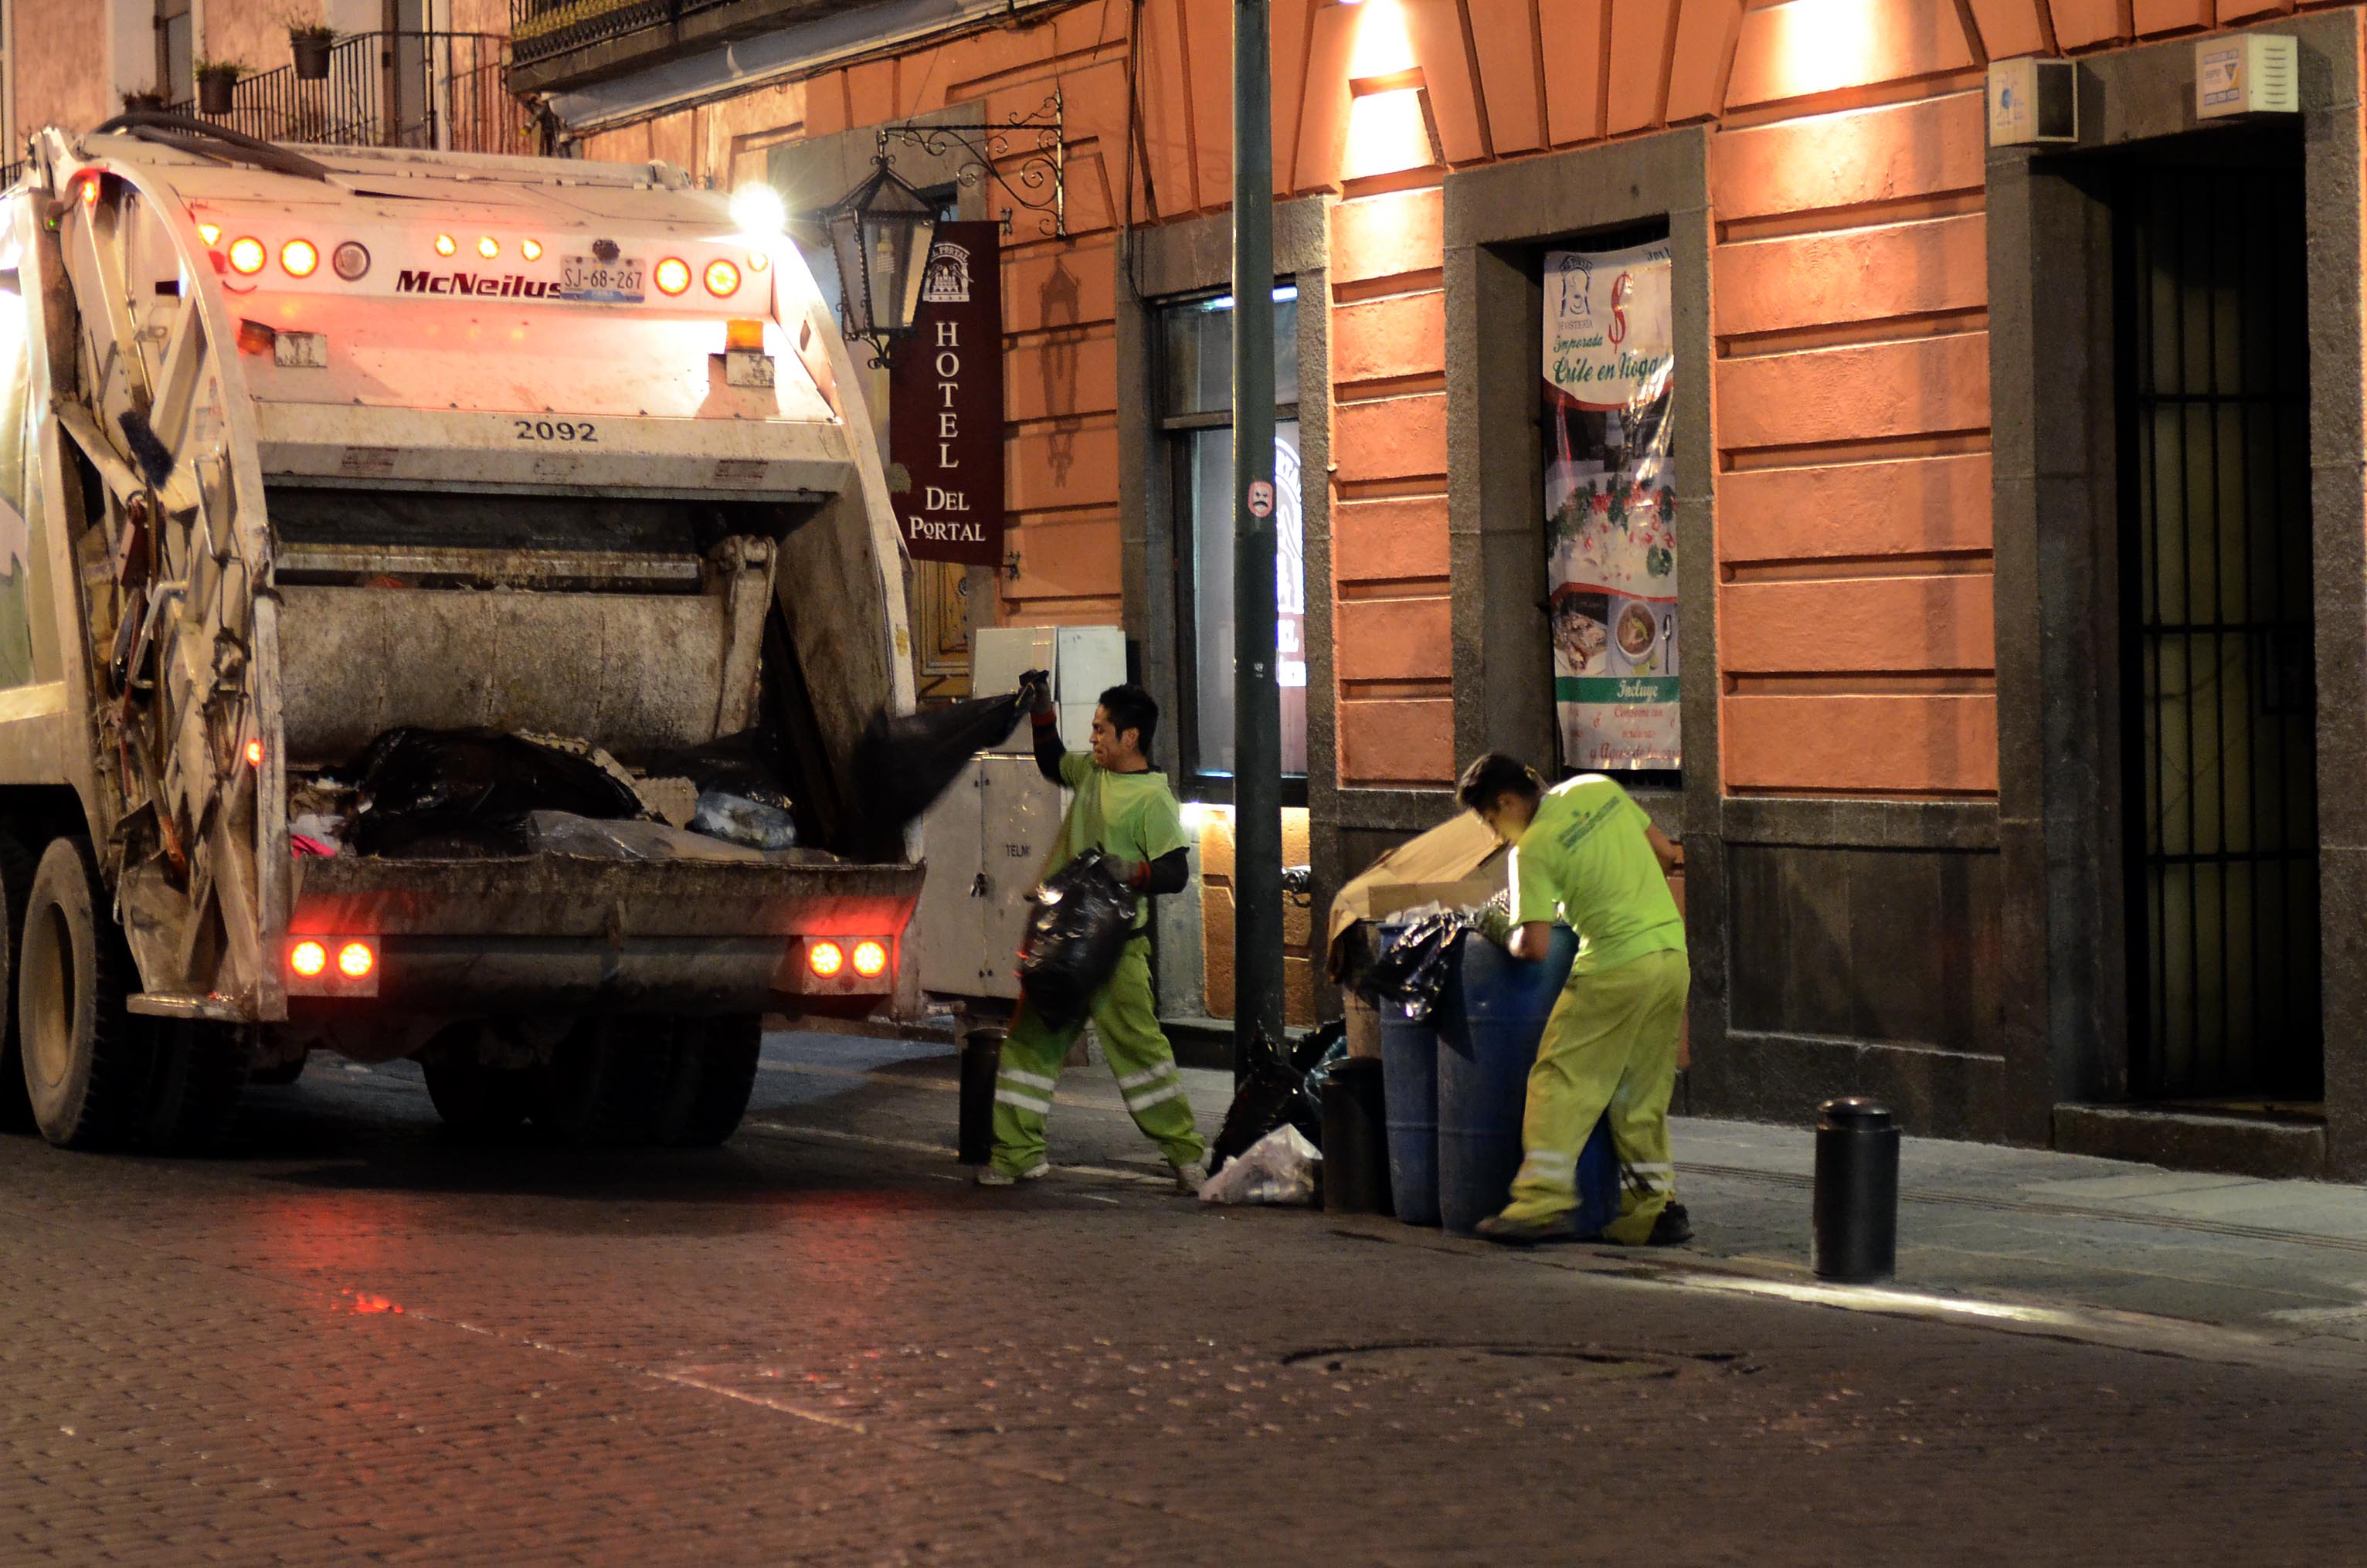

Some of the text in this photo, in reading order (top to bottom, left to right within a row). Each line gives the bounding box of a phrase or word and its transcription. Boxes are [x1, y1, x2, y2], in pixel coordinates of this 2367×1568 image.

[396, 270, 561, 299] McNeilus
[564, 268, 643, 290] SJ-68-267
[1597, 363, 1615, 382] en
[935, 321, 959, 468] HOTEL
[514, 420, 599, 443] 2092
[908, 516, 987, 542] PORTAL
